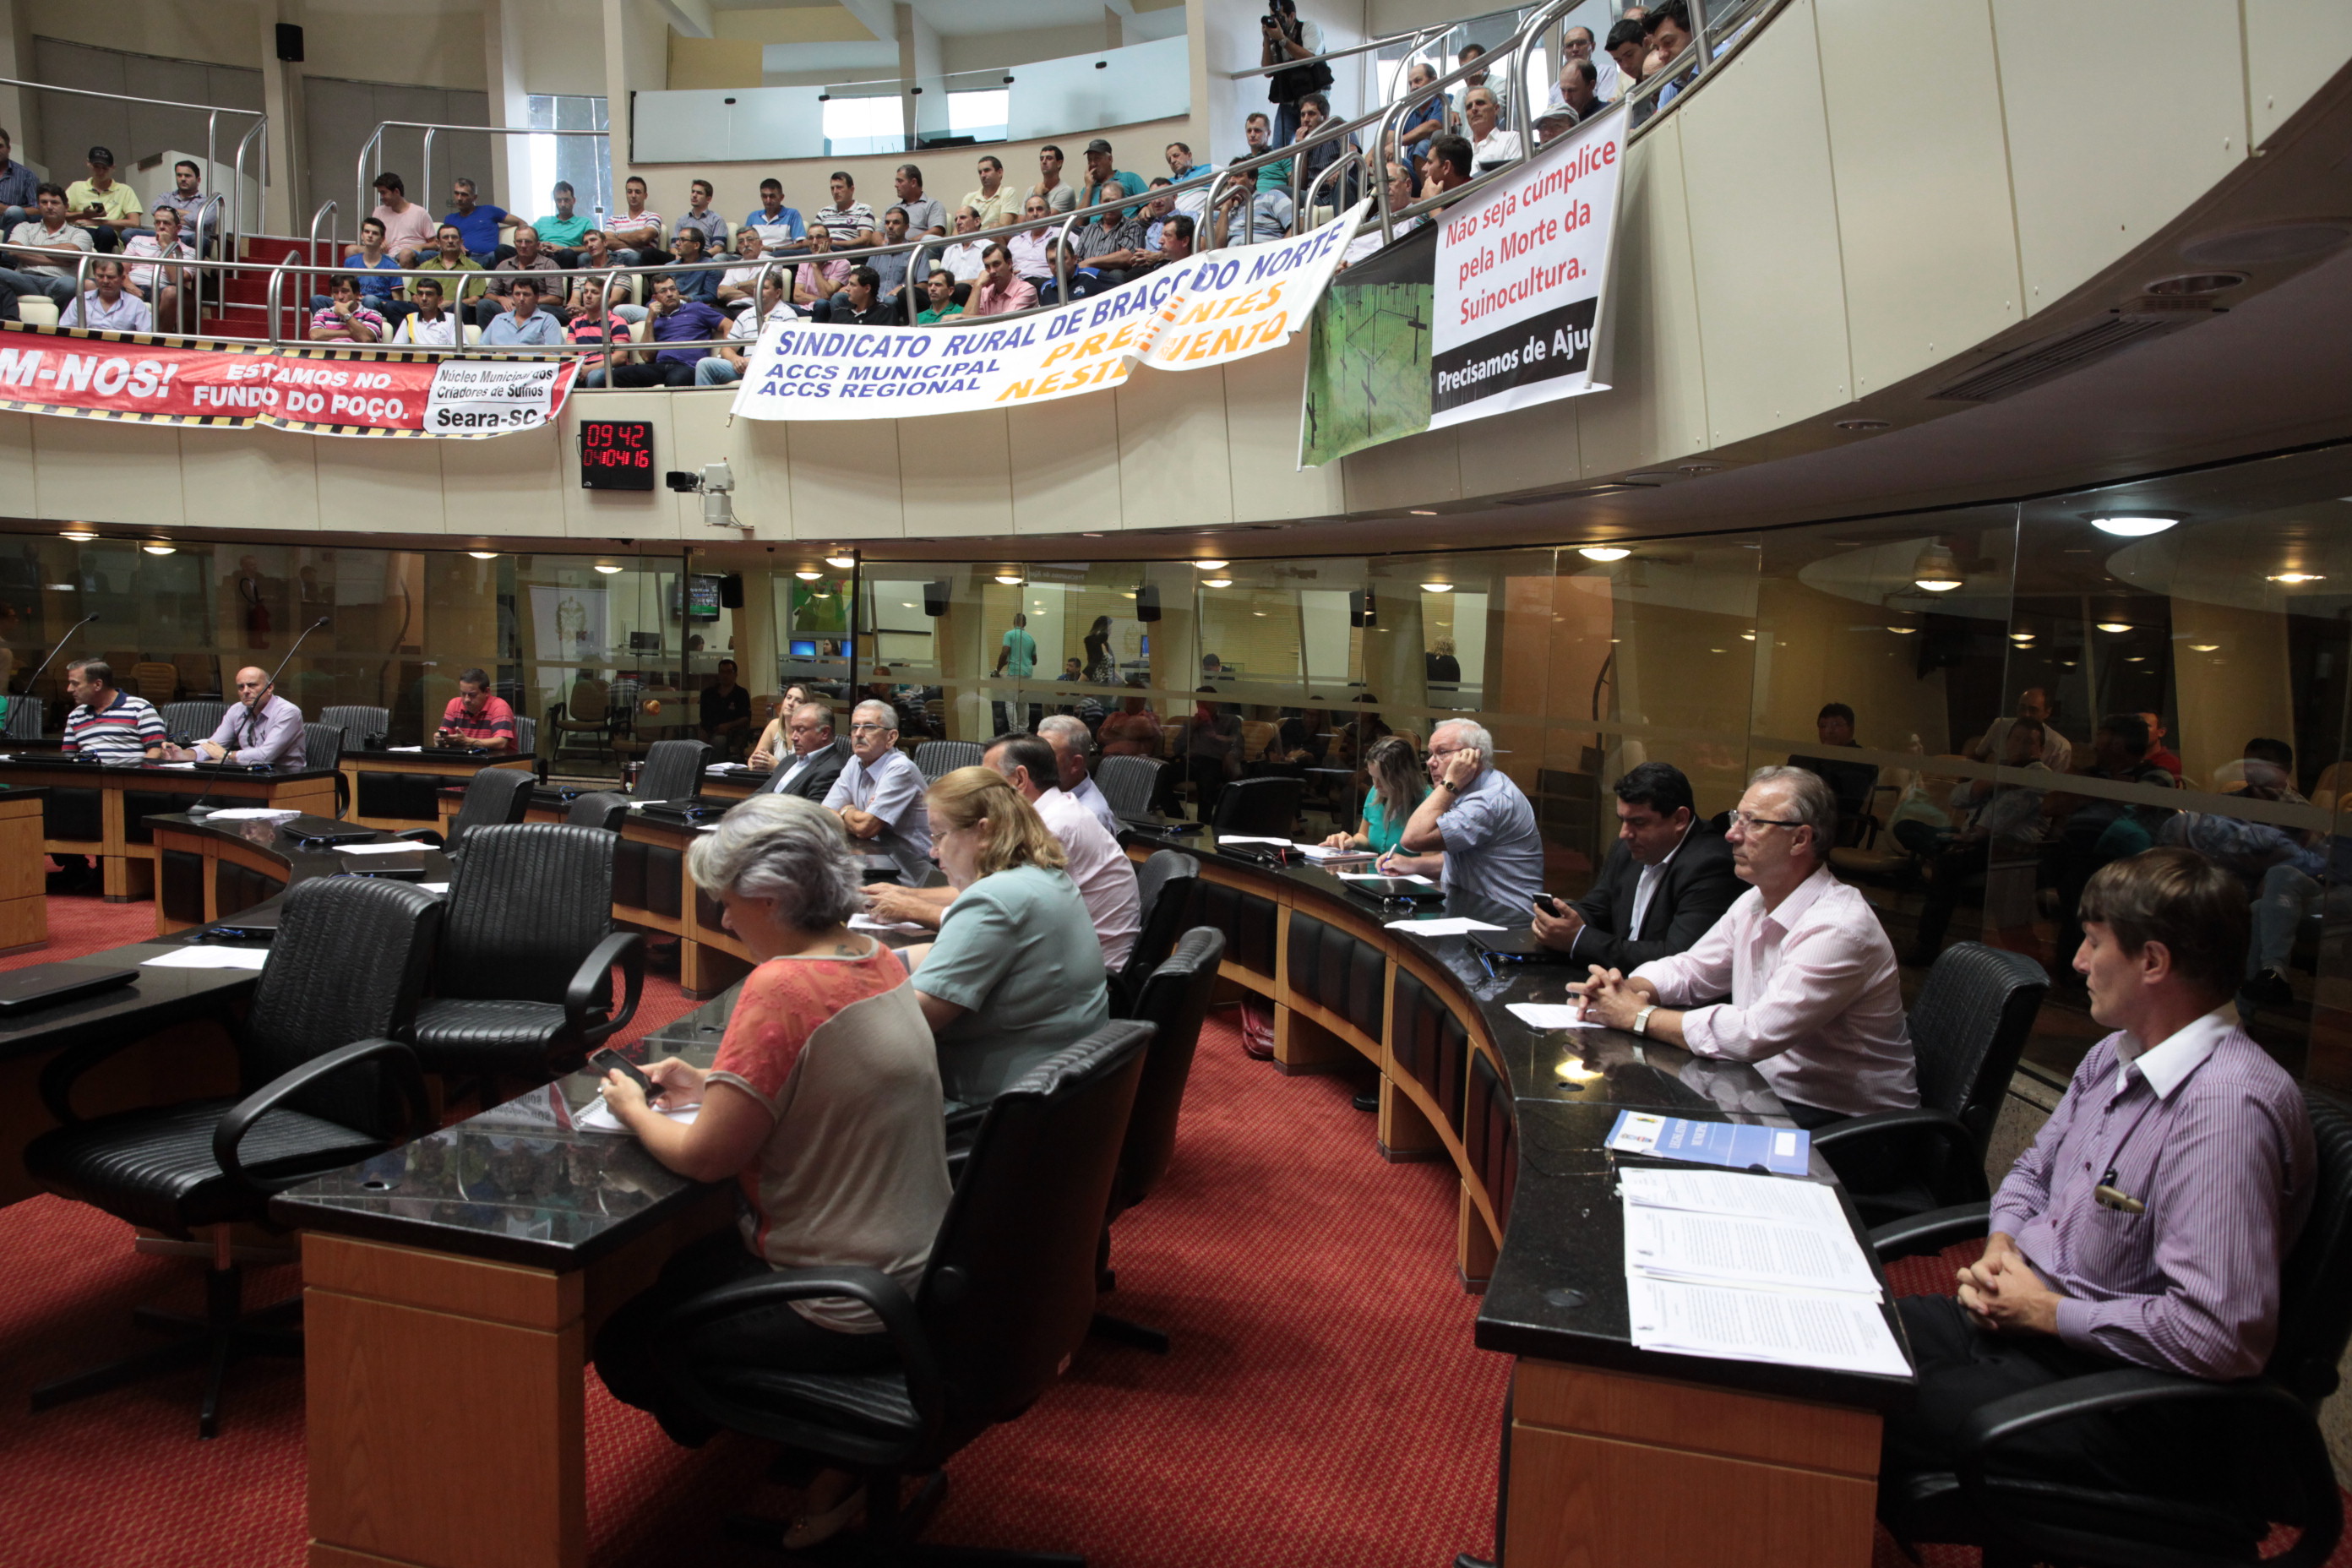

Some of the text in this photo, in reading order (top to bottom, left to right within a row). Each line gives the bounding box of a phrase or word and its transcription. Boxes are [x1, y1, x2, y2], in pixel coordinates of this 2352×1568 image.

[1446, 140, 1616, 248] Não seja cúmplice
[1459, 199, 1591, 290] pela Morte da
[775, 330, 931, 358] SINDICATO
[941, 323, 1036, 357] RURAL
[1045, 306, 1087, 341] DE
[1190, 259, 1240, 292] DO
[1245, 220, 1345, 284] NORTE
[1461, 257, 1587, 325] Suinocultura.
[226, 362, 348, 387] ESTAMOS
[353, 373, 391, 389] NO
[439, 369, 477, 383] Núcleo
[480, 370, 531, 383] Municipal
[765, 359, 1000, 380] ACCS MUNICIPAL
[1438, 347, 1519, 395] Precisamos
[1522, 336, 1546, 364] de
[193, 385, 409, 422] FUNDO DO POÇO.
[438, 386, 488, 398] Criadores
[491, 386, 504, 397] de
[757, 378, 981, 398] ACCS REGIONAL
[437, 408, 538, 427] Seara-SC
